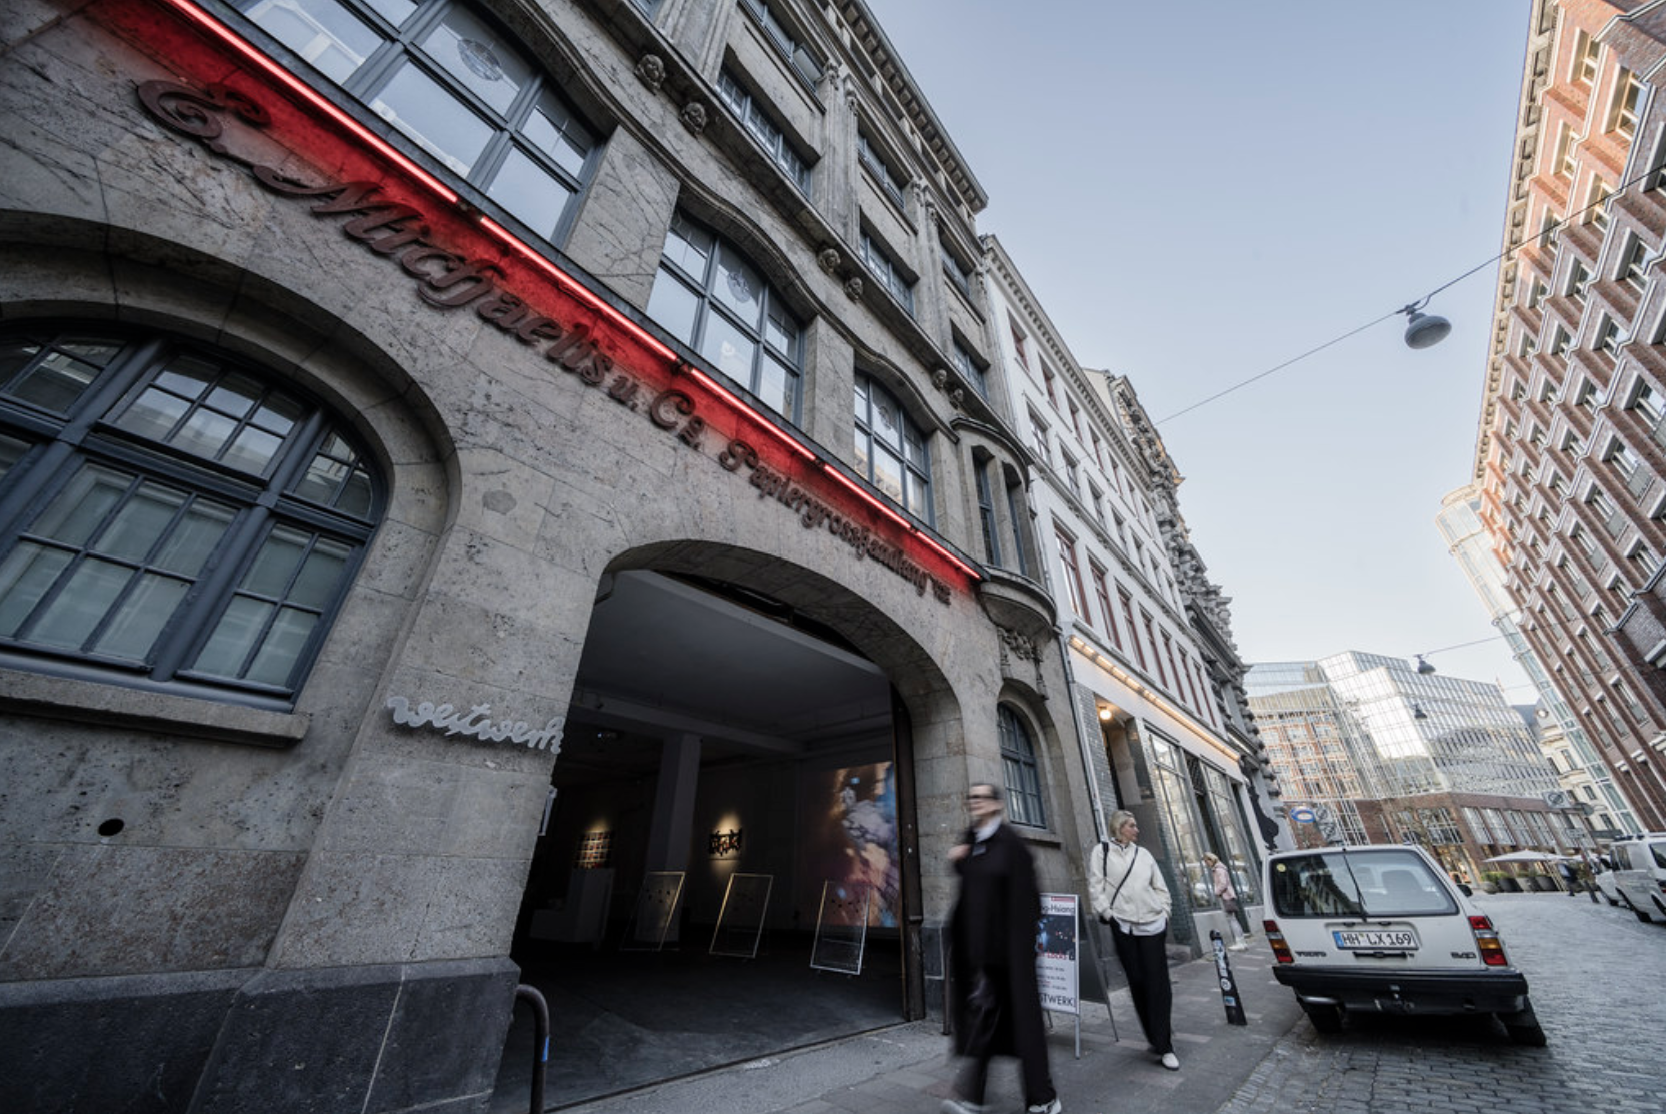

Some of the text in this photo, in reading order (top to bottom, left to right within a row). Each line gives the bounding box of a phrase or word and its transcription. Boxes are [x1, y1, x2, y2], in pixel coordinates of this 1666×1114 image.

[252, 164, 613, 386] Michaelis
[1342, 933, 1412, 945] HH LX 169
